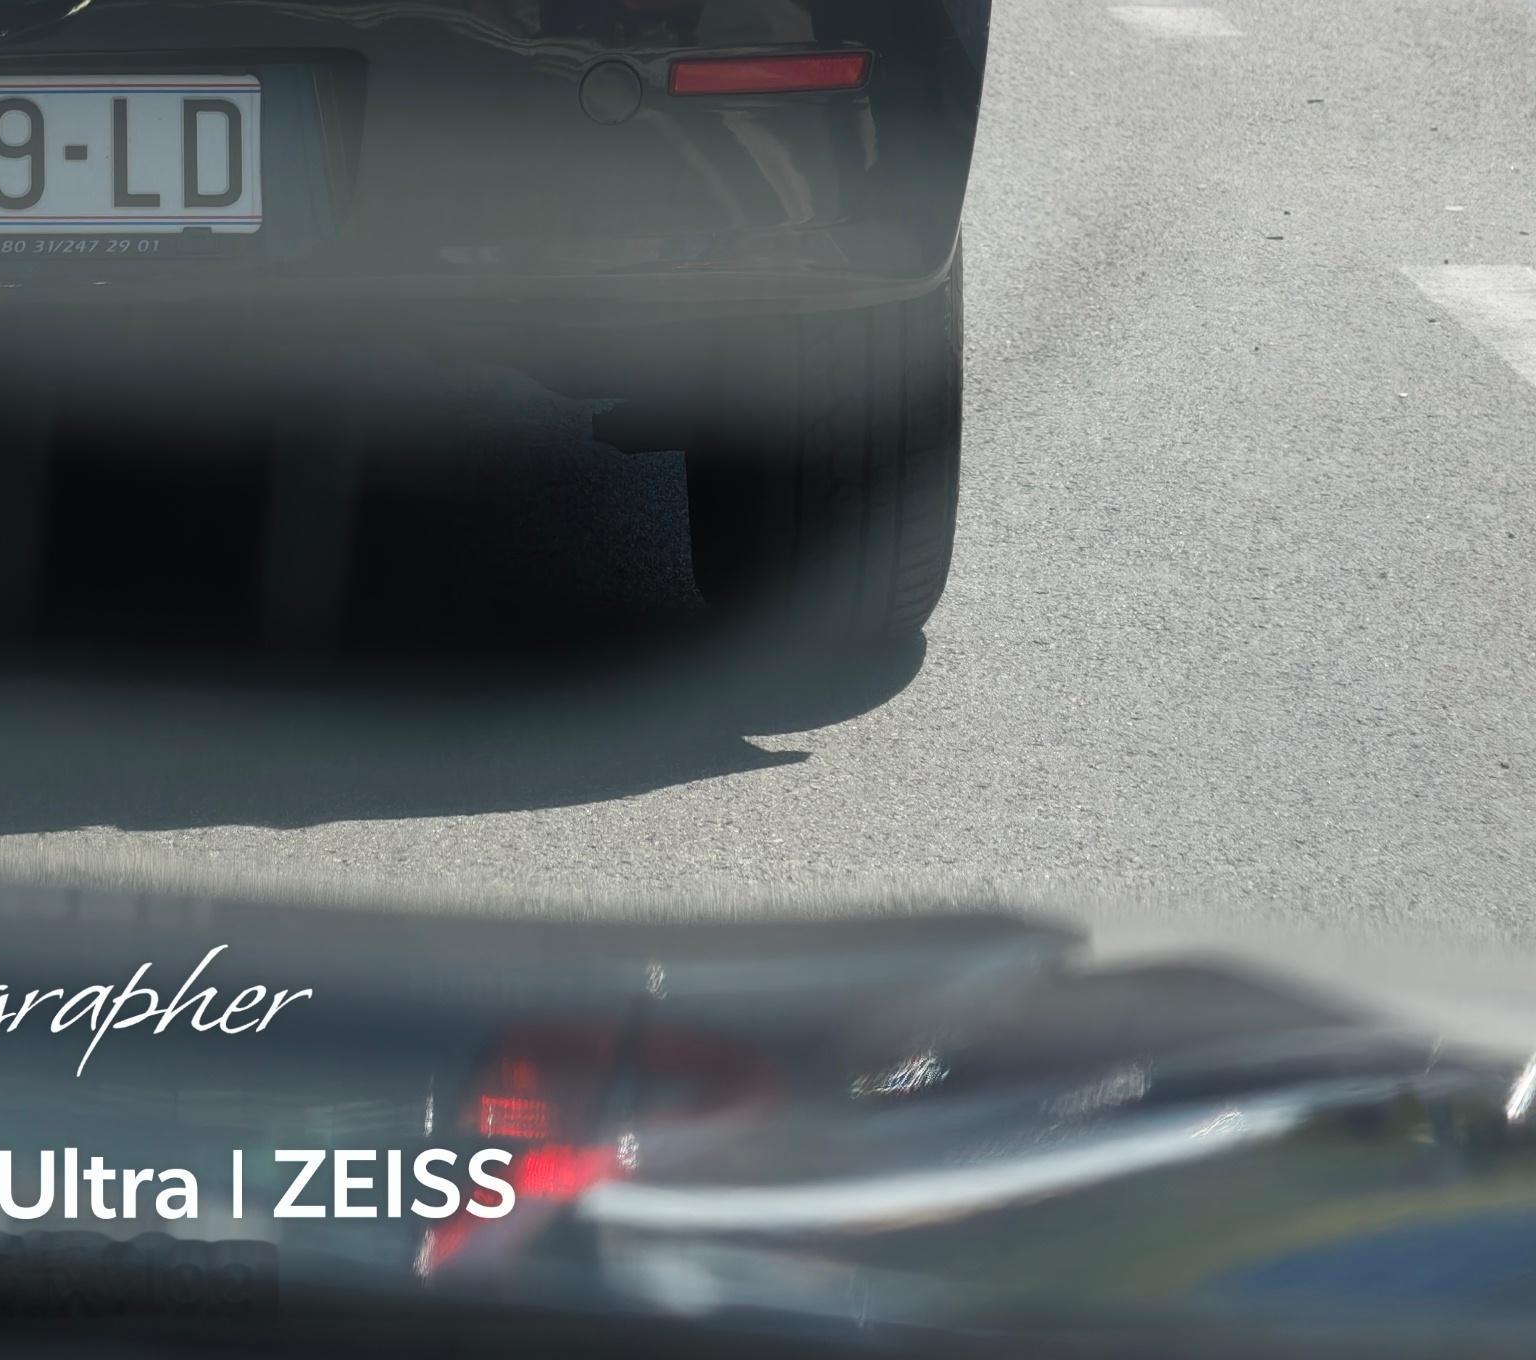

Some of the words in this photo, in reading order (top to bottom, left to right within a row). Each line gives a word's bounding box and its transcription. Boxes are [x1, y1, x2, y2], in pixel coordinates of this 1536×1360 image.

[2, 240, 26, 253] 80
[32, 239, 99, 253] 31/247
[106, 239, 131, 253] 29
[138, 239, 160, 253] 01
